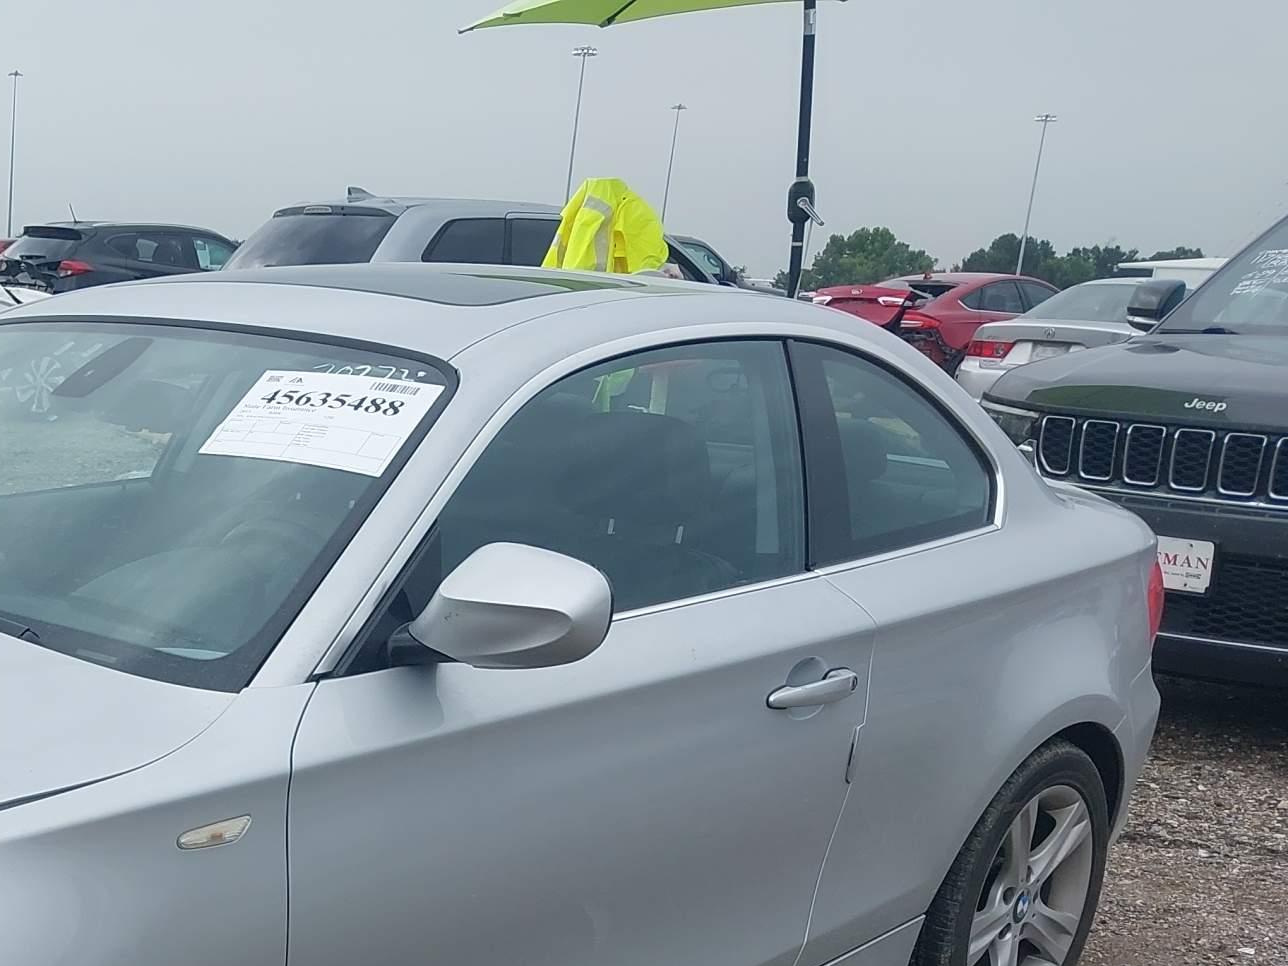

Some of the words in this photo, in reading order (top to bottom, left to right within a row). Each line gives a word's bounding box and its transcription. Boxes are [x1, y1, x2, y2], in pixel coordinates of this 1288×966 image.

[261, 389, 405, 417] 45635488
[1184, 398, 1227, 412] Jeep
[1157, 551, 1210, 571] MAN
